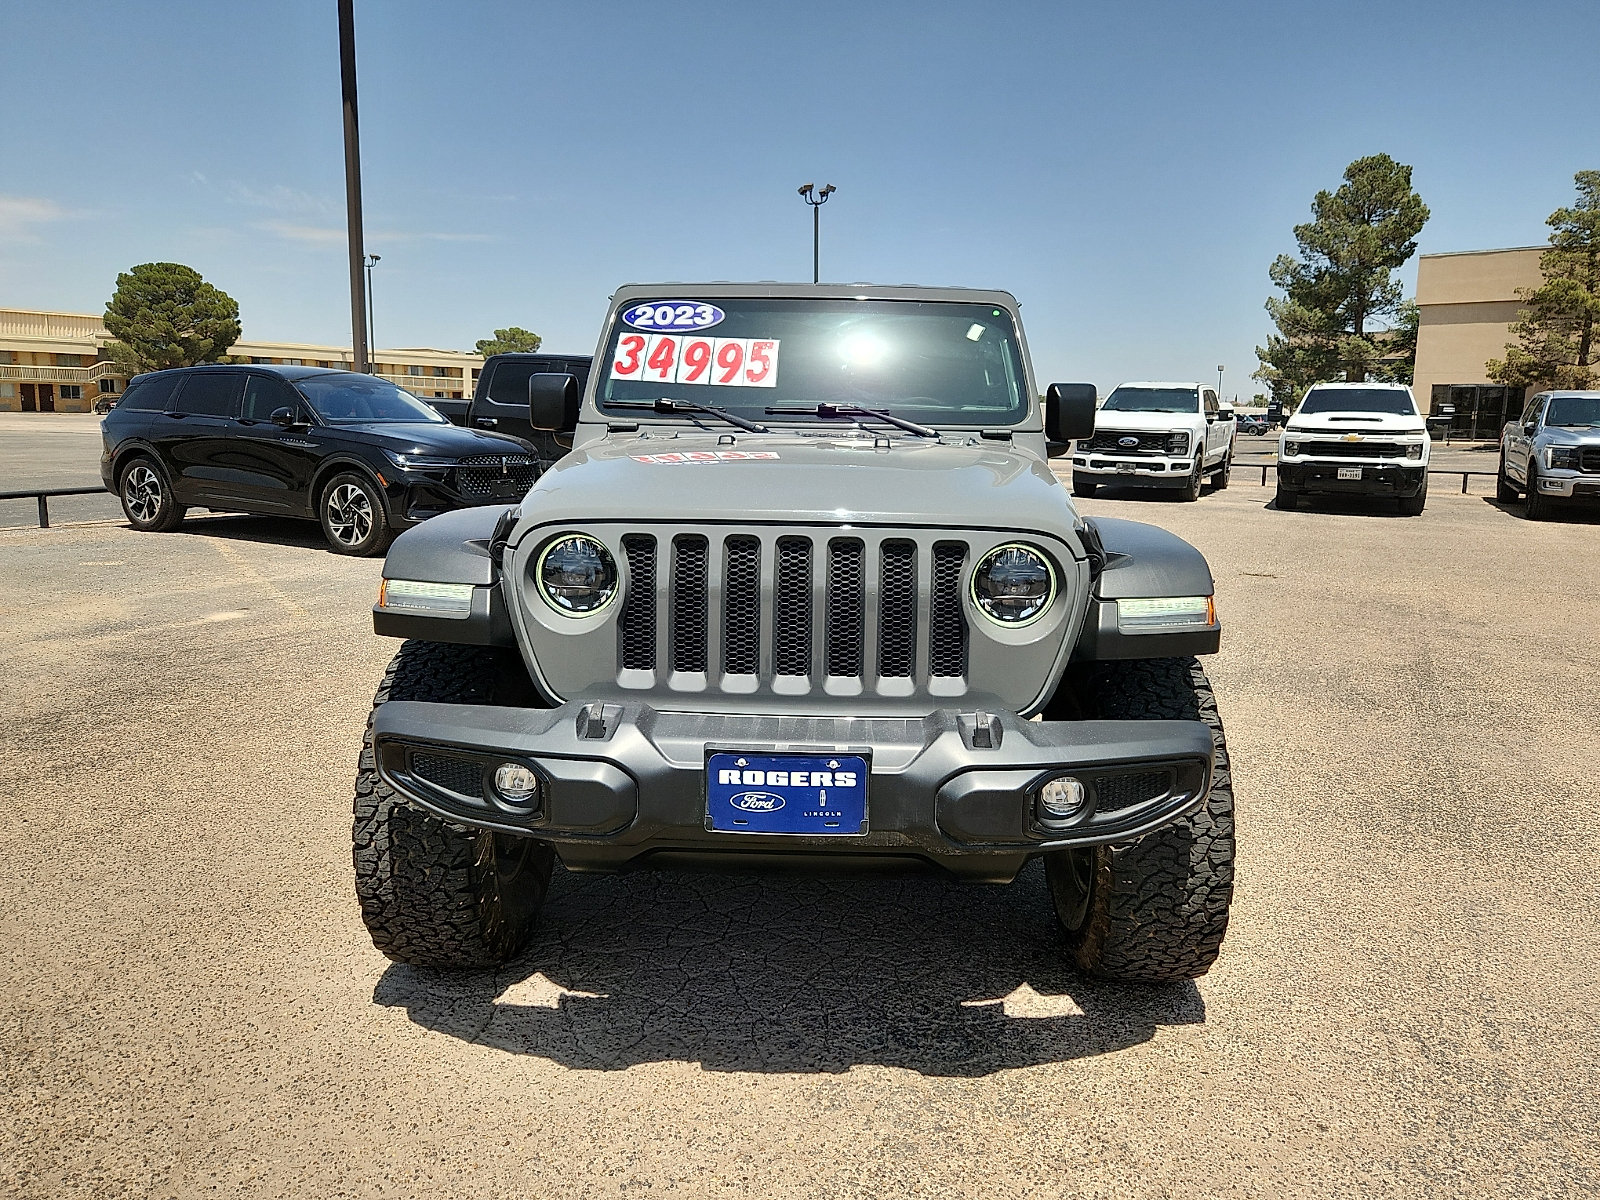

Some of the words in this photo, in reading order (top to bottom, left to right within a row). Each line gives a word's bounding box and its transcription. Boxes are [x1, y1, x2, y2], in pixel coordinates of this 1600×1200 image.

[633, 305, 714, 326] 2023
[615, 335, 774, 383] 34995
[718, 769, 857, 787] ROGERS
[740, 794, 775, 809] Ford
